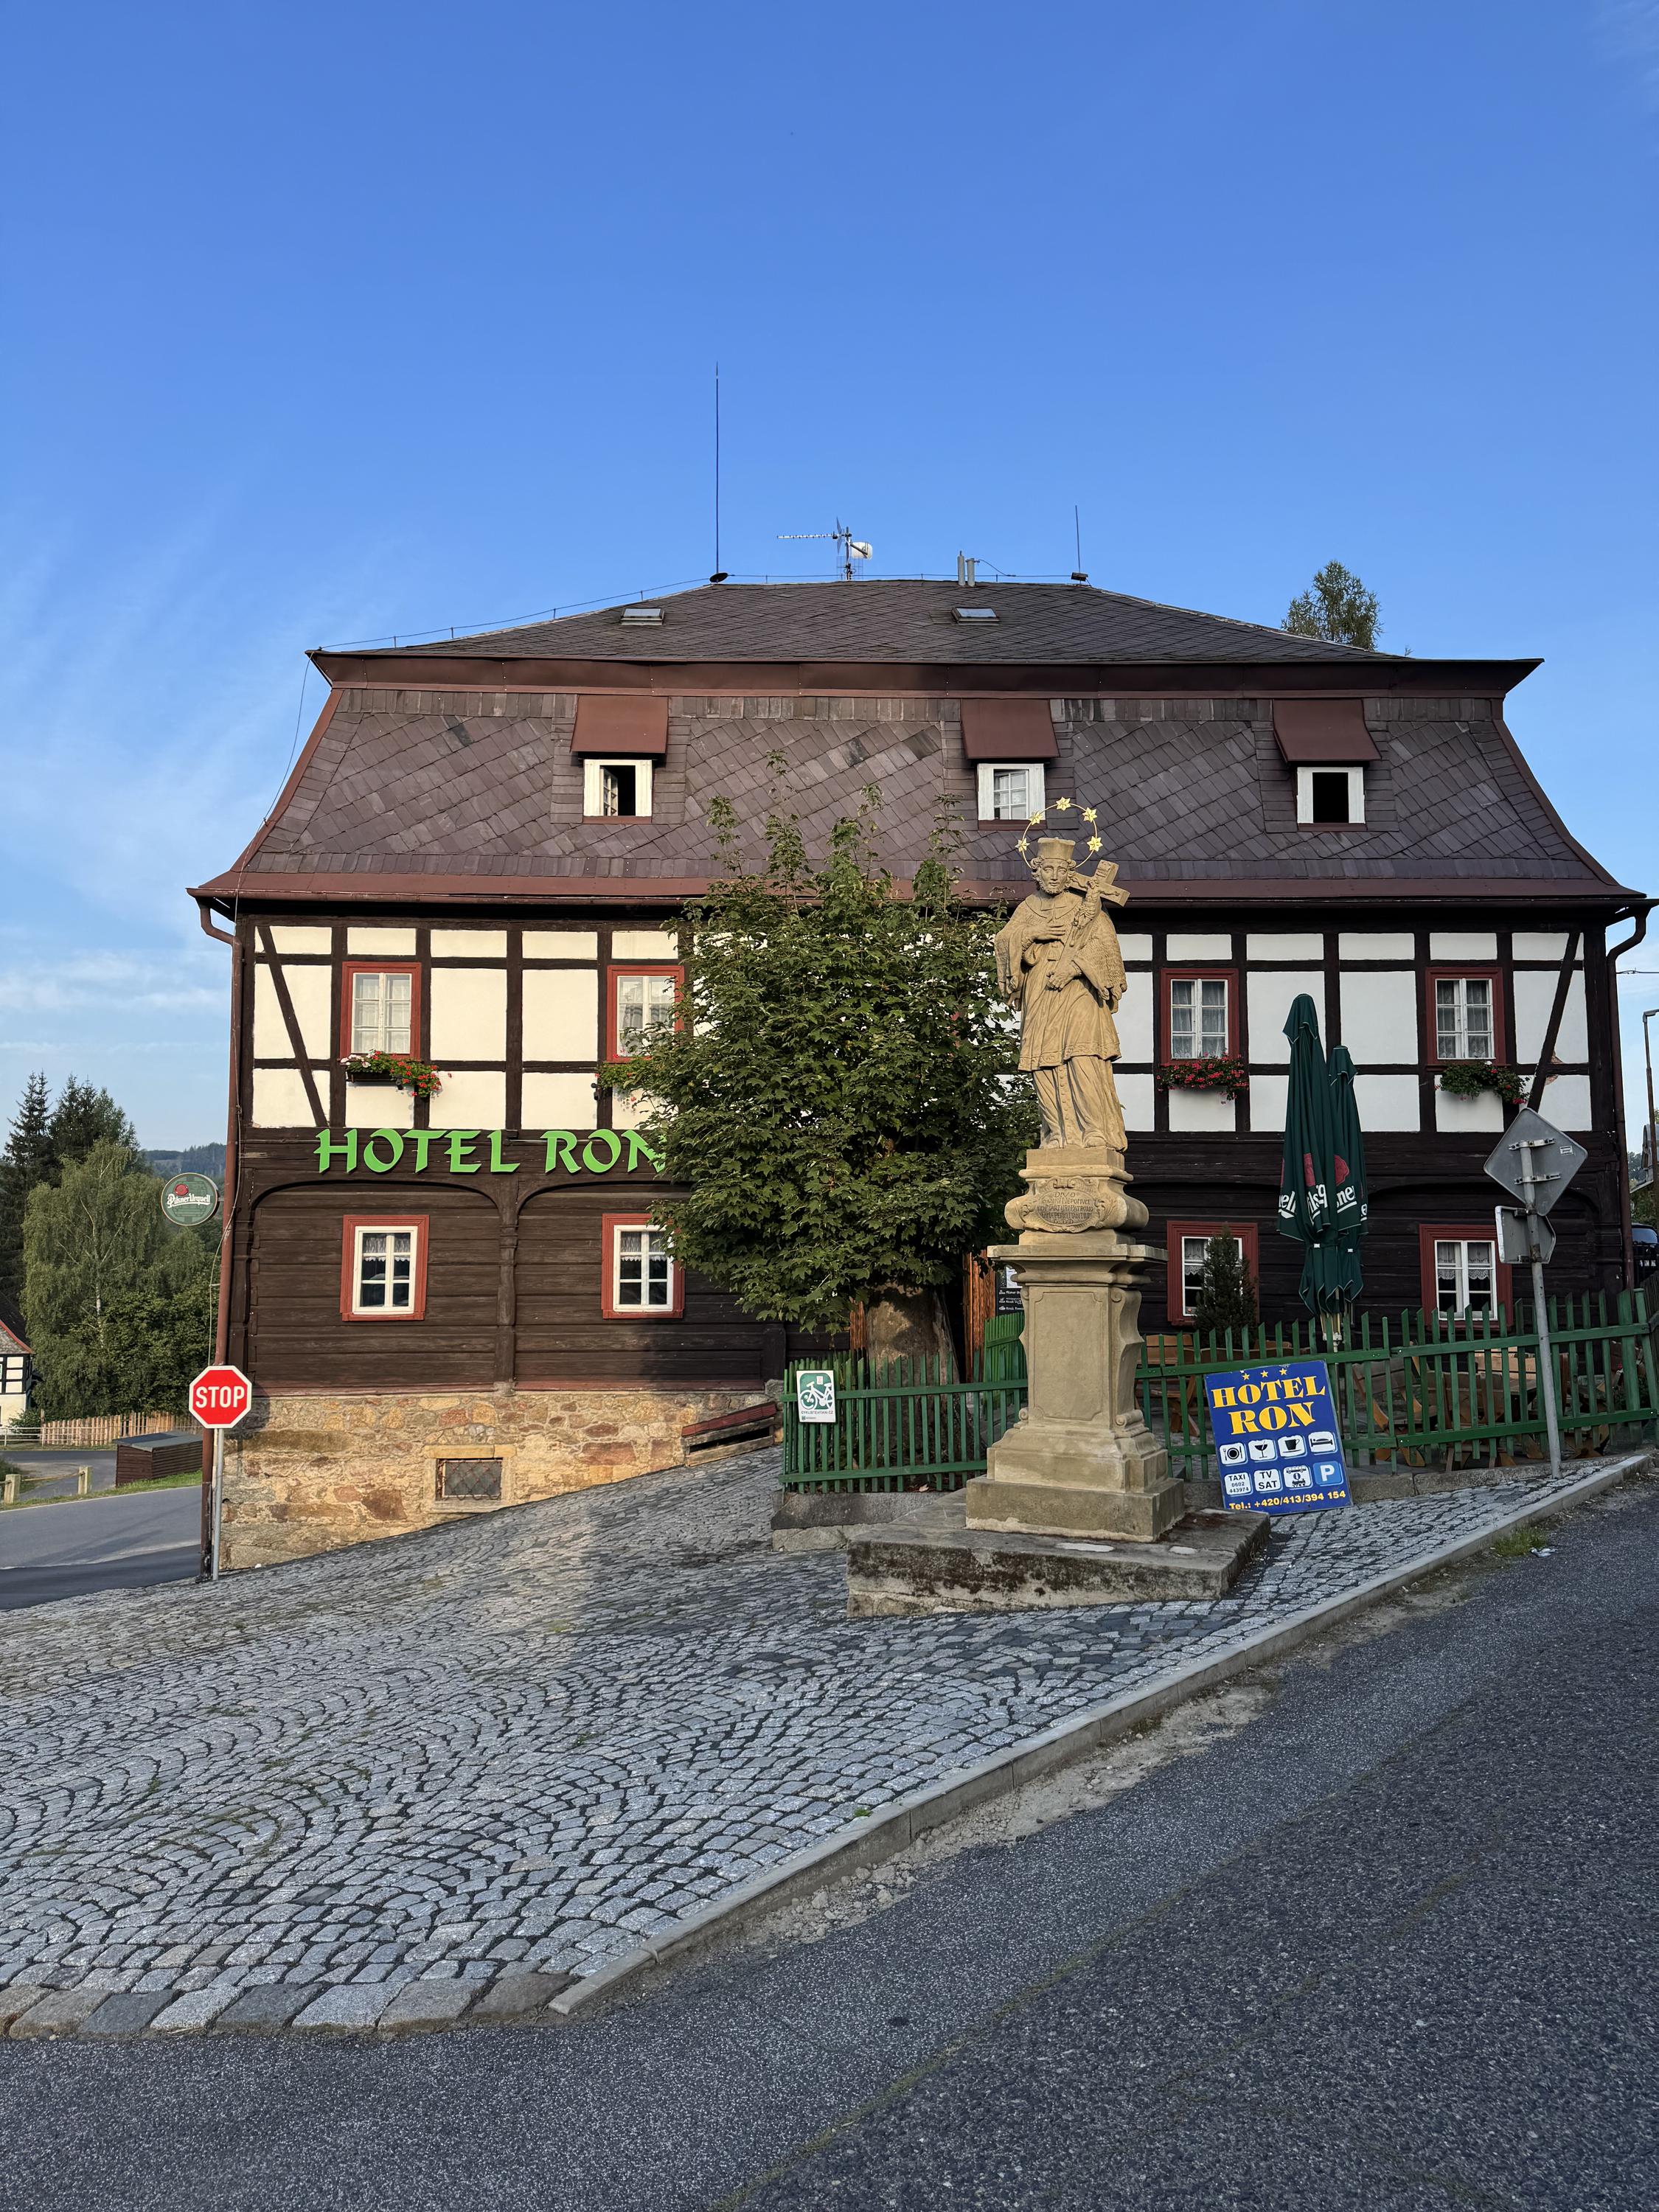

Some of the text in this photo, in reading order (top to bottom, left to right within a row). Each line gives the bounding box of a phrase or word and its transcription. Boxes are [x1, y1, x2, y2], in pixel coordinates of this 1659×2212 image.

[313, 1129, 520, 1174] HOTEL
[195, 1386, 245, 1408] STOP
[1211, 1376, 1325, 1408] HOTEL
[1228, 1402, 1315, 1435] RON
[1260, 1471, 1272, 1479] TV
[1320, 1465, 1335, 1481] P
[1259, 1481, 1277, 1489] SAT
[1229, 1490, 1346, 1510] Tel.: +420/413/394 154
